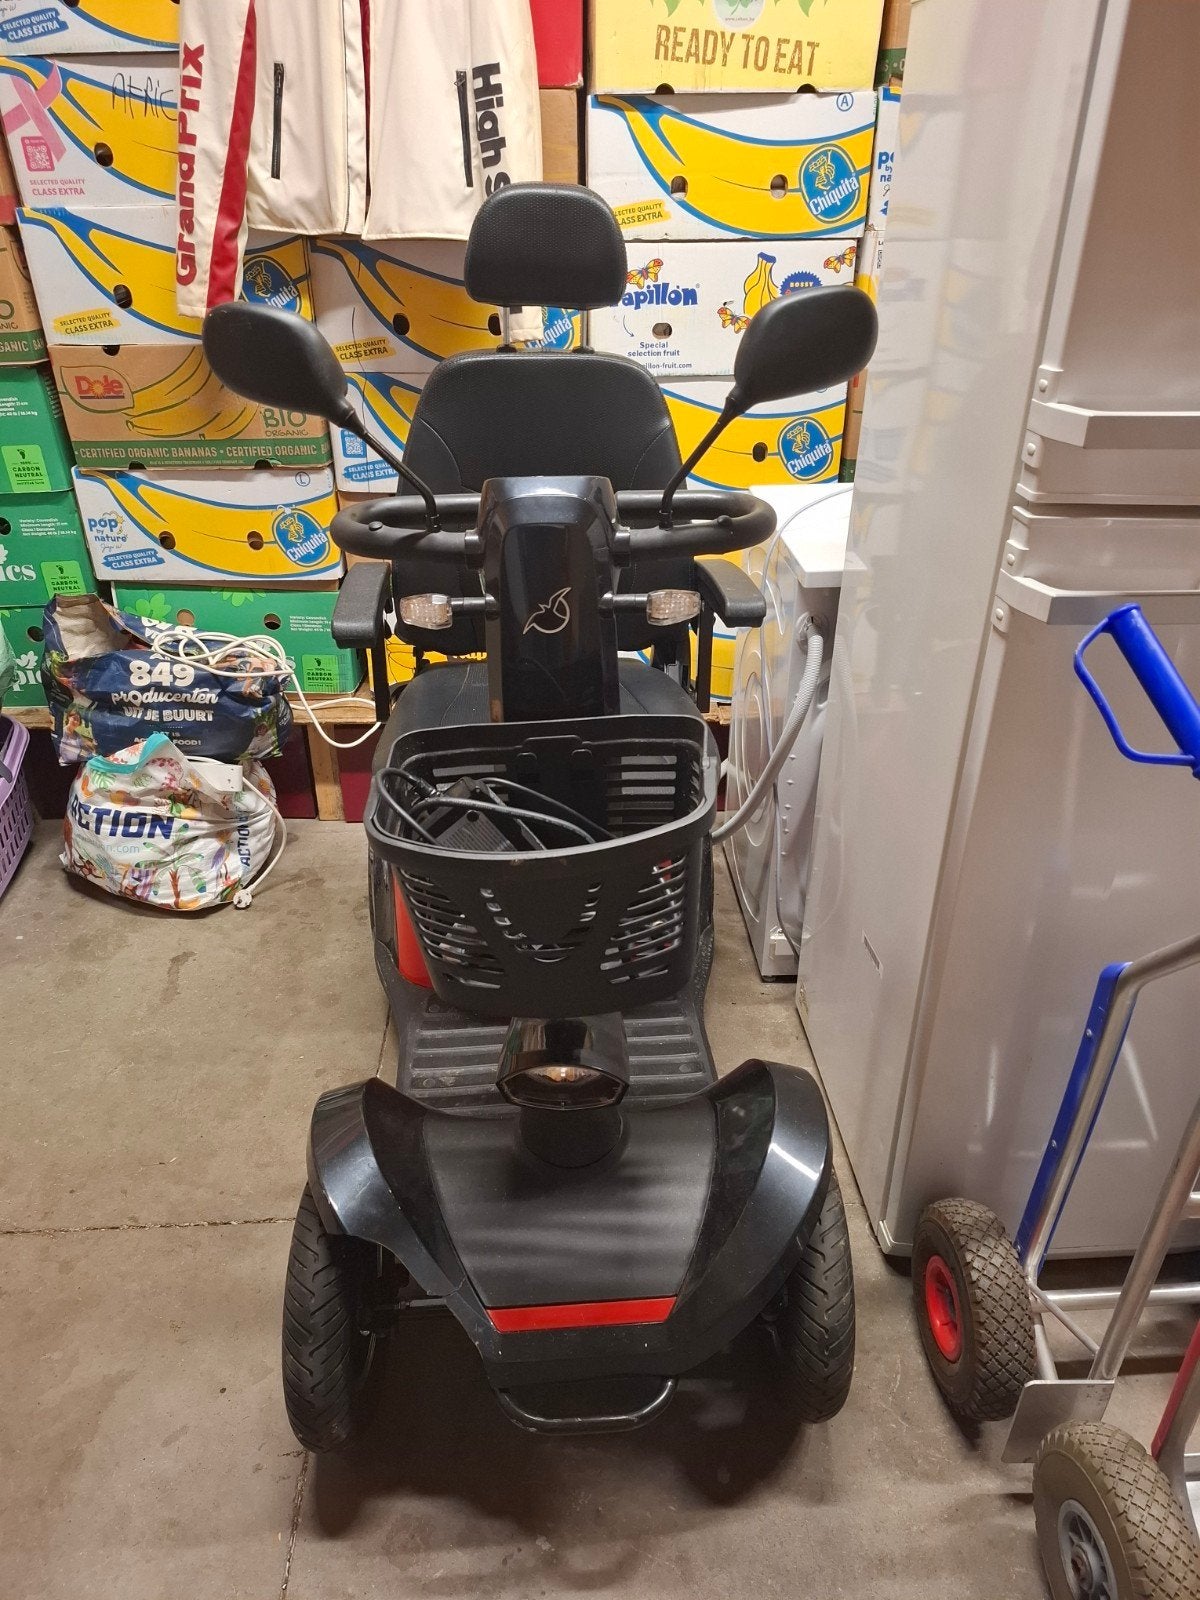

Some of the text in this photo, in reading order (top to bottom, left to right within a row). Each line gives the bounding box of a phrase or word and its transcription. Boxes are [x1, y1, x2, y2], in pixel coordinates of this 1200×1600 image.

[3, 11, 56, 31] SELECTED QUALITY
[8, 20, 60, 40] CLASS EXTRA
[654, 24, 820, 76] READY TO EAT
[176, 42, 205, 286] Grand Prix
[59, 178, 85, 186] QUALITY
[32, 187, 85, 196] CLASS EXTRA
[809, 176, 859, 216] Chiquita
[614, 202, 663, 217] LECTED QUALITY
[619, 211, 663, 225] ASS EXTRA
[265, 285, 299, 309] iquita
[60, 312, 111, 326] SELECTED QUALITY
[65, 320, 113, 335] CLASS EXTRA
[336, 339, 386, 352] SELECTED QUALITY
[640, 341, 668, 350] Special
[340, 346, 389, 360] CLASS EXTRA
[663, 349, 680, 357] fruit
[75, 375, 124, 395] Dole
[265, 429, 309, 437] ORGANIC
[80, 448, 125, 458] CERTIFIED
[128, 447, 170, 458] ORGANIC
[172, 446, 218, 457] BANANAS
[226, 446, 273, 457] CERTIFIED
[275, 444, 317, 456] ORGANIC
[787, 441, 832, 475] Chiquita
[88, 518, 118, 532] pop
[95, 534, 127, 542] nature
[287, 532, 328, 561] Chiquita
[108, 550, 155, 562] SELECTED QUALITY
[112, 557, 158, 569] CLASS EXTRA
[129, 660, 195, 687] 849
[111, 687, 219, 706] producenten
[144, 708, 160, 722] JE
[163, 708, 214, 722] BUURT
[71, 794, 175, 839] ACTION
